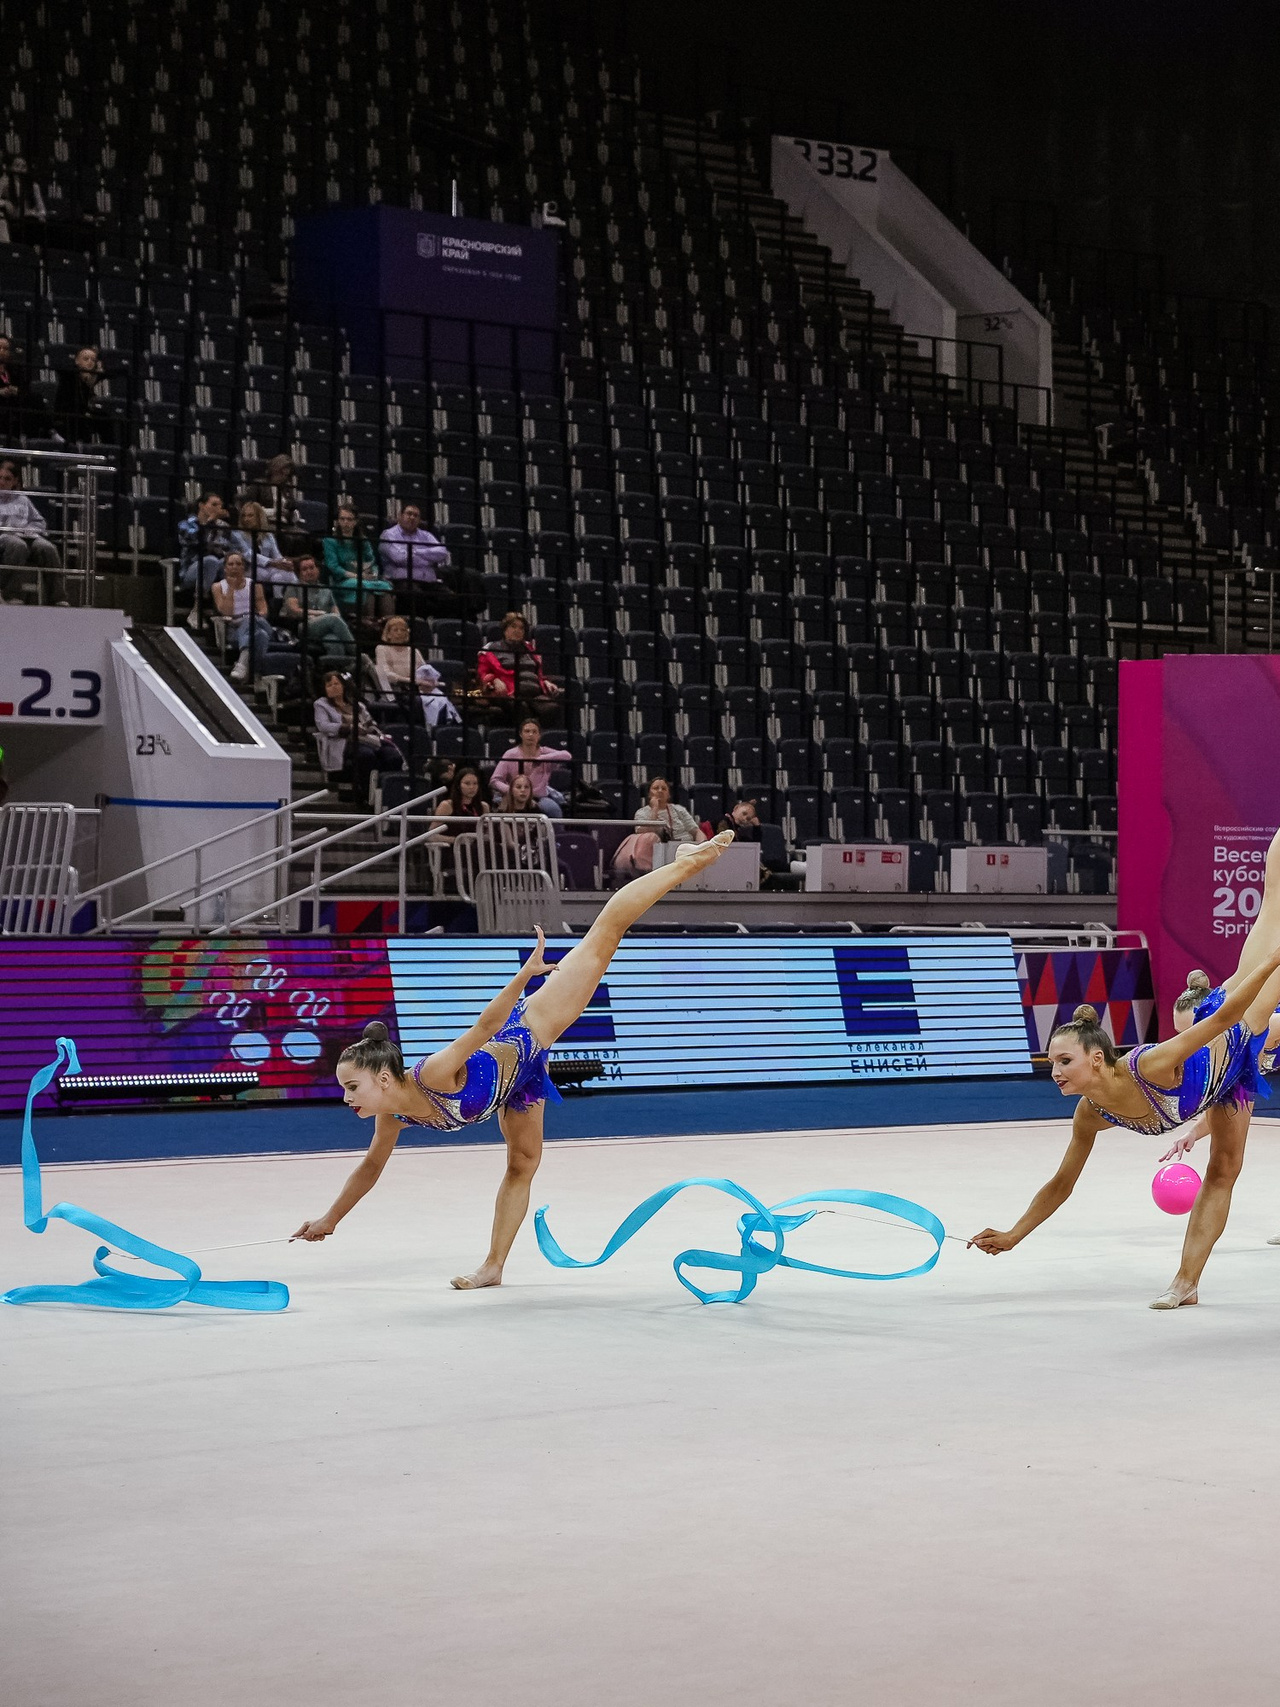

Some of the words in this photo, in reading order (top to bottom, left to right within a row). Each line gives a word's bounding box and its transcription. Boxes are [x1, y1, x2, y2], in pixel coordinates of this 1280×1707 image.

[441, 236, 522, 257] КРАСНОЯРСКИЙ
[441, 248, 470, 260] КРАЙ
[18, 668, 101, 718] 2.3
[551, 1049, 620, 1060] леканал
[847, 1041, 925, 1053] телеканал
[850, 1054, 929, 1074] ЕНИСЕЙ
